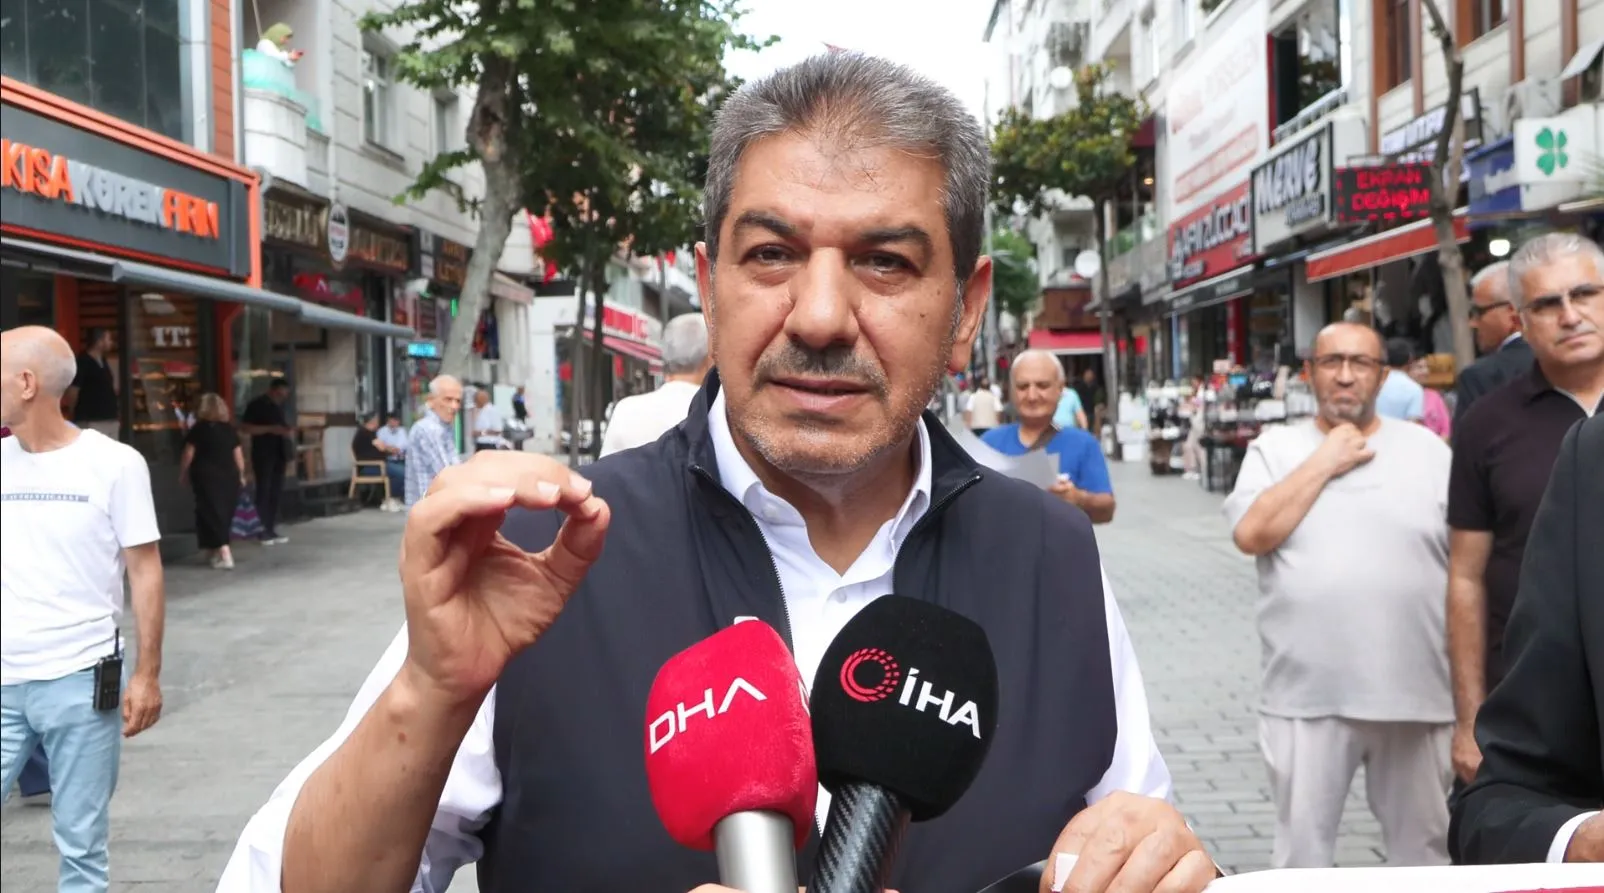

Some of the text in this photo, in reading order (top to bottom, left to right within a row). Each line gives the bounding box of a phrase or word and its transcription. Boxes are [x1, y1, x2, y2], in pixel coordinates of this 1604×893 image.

[1256, 137, 1320, 217] MERVE
[648, 676, 768, 755] DHA
[898, 666, 982, 740] İHA
